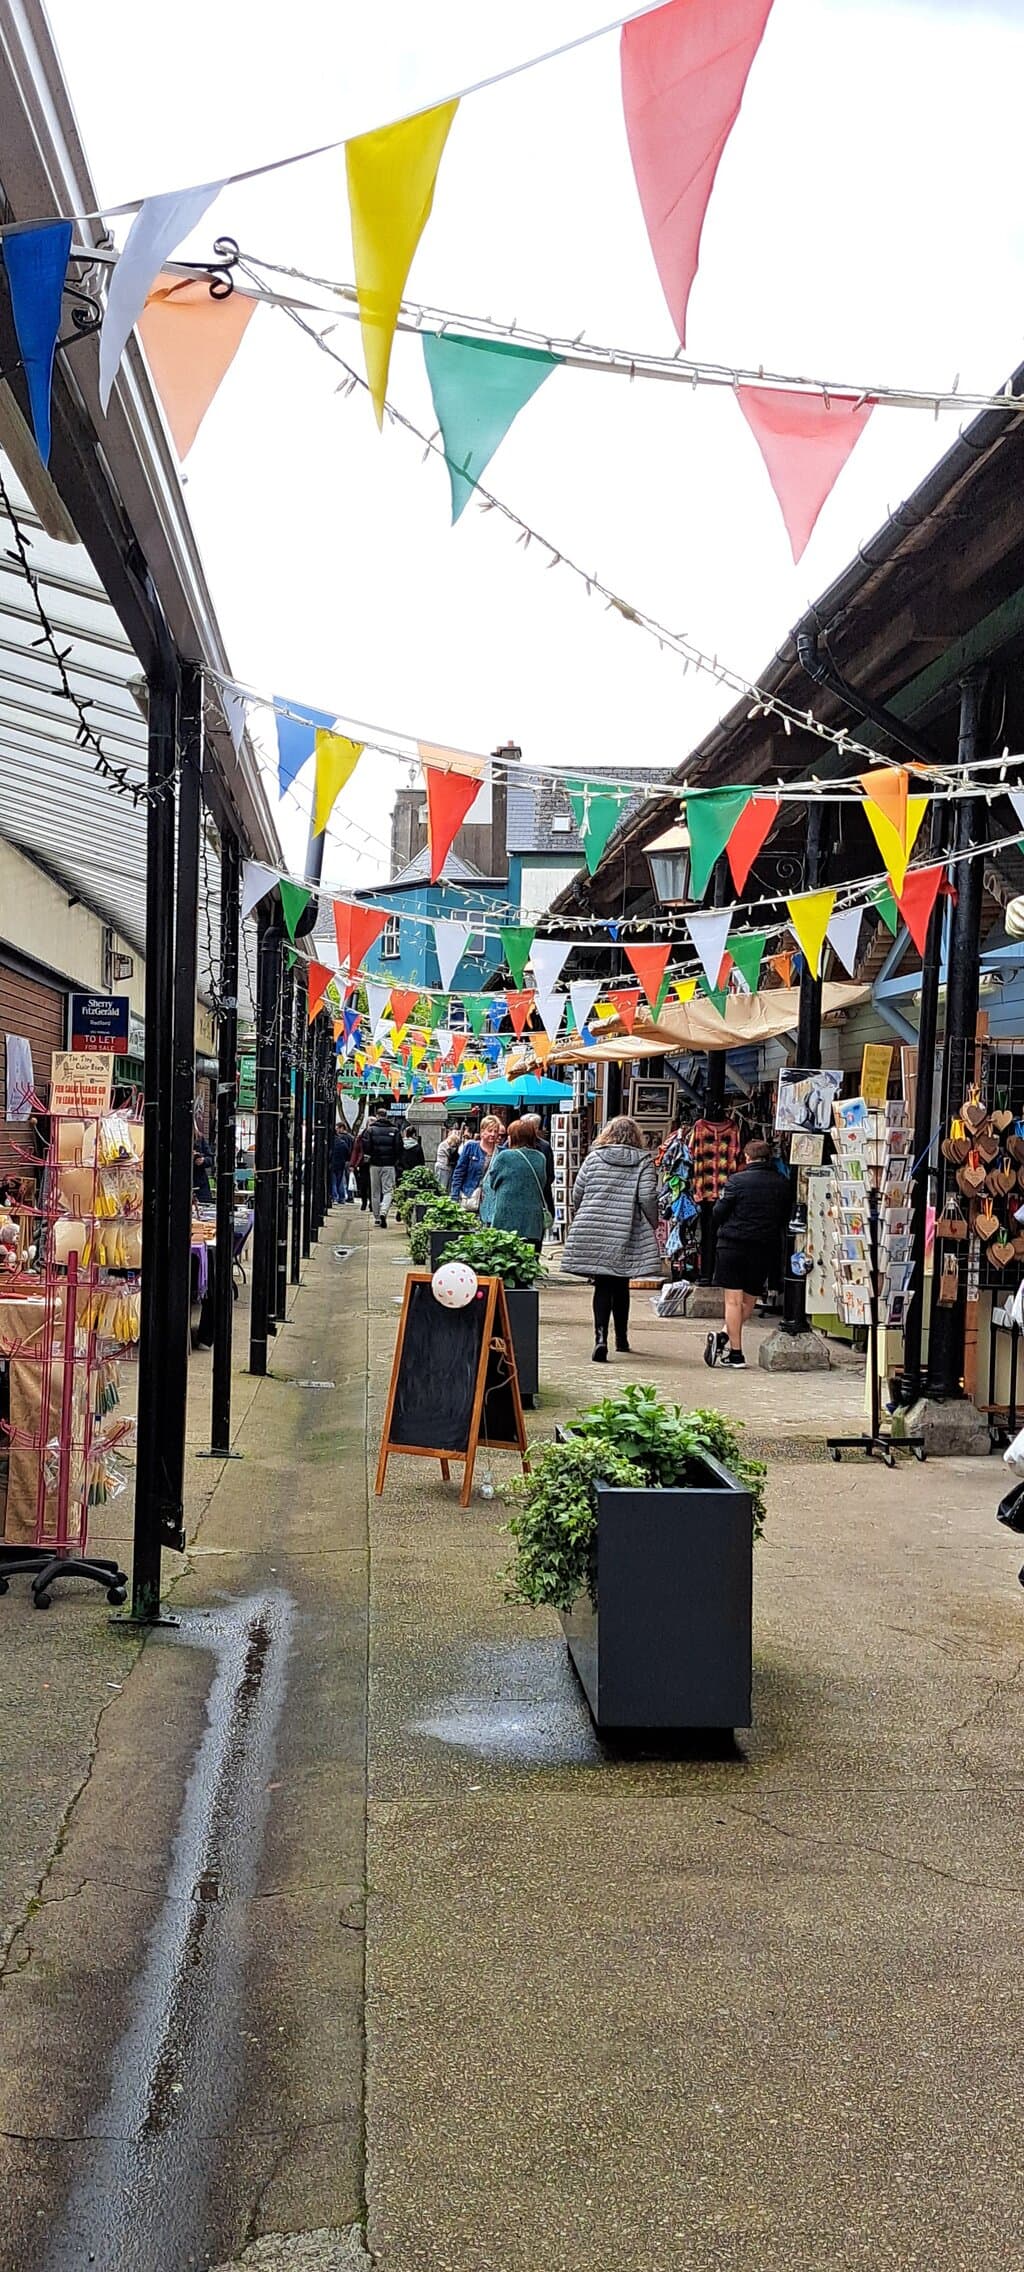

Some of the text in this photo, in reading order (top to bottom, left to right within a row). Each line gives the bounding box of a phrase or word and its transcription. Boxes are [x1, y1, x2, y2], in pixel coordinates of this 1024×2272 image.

[88, 999, 113, 1008] Sherry
[81, 1006, 120, 1016] FitzGerald
[84, 1034, 116, 1044] TO LET
